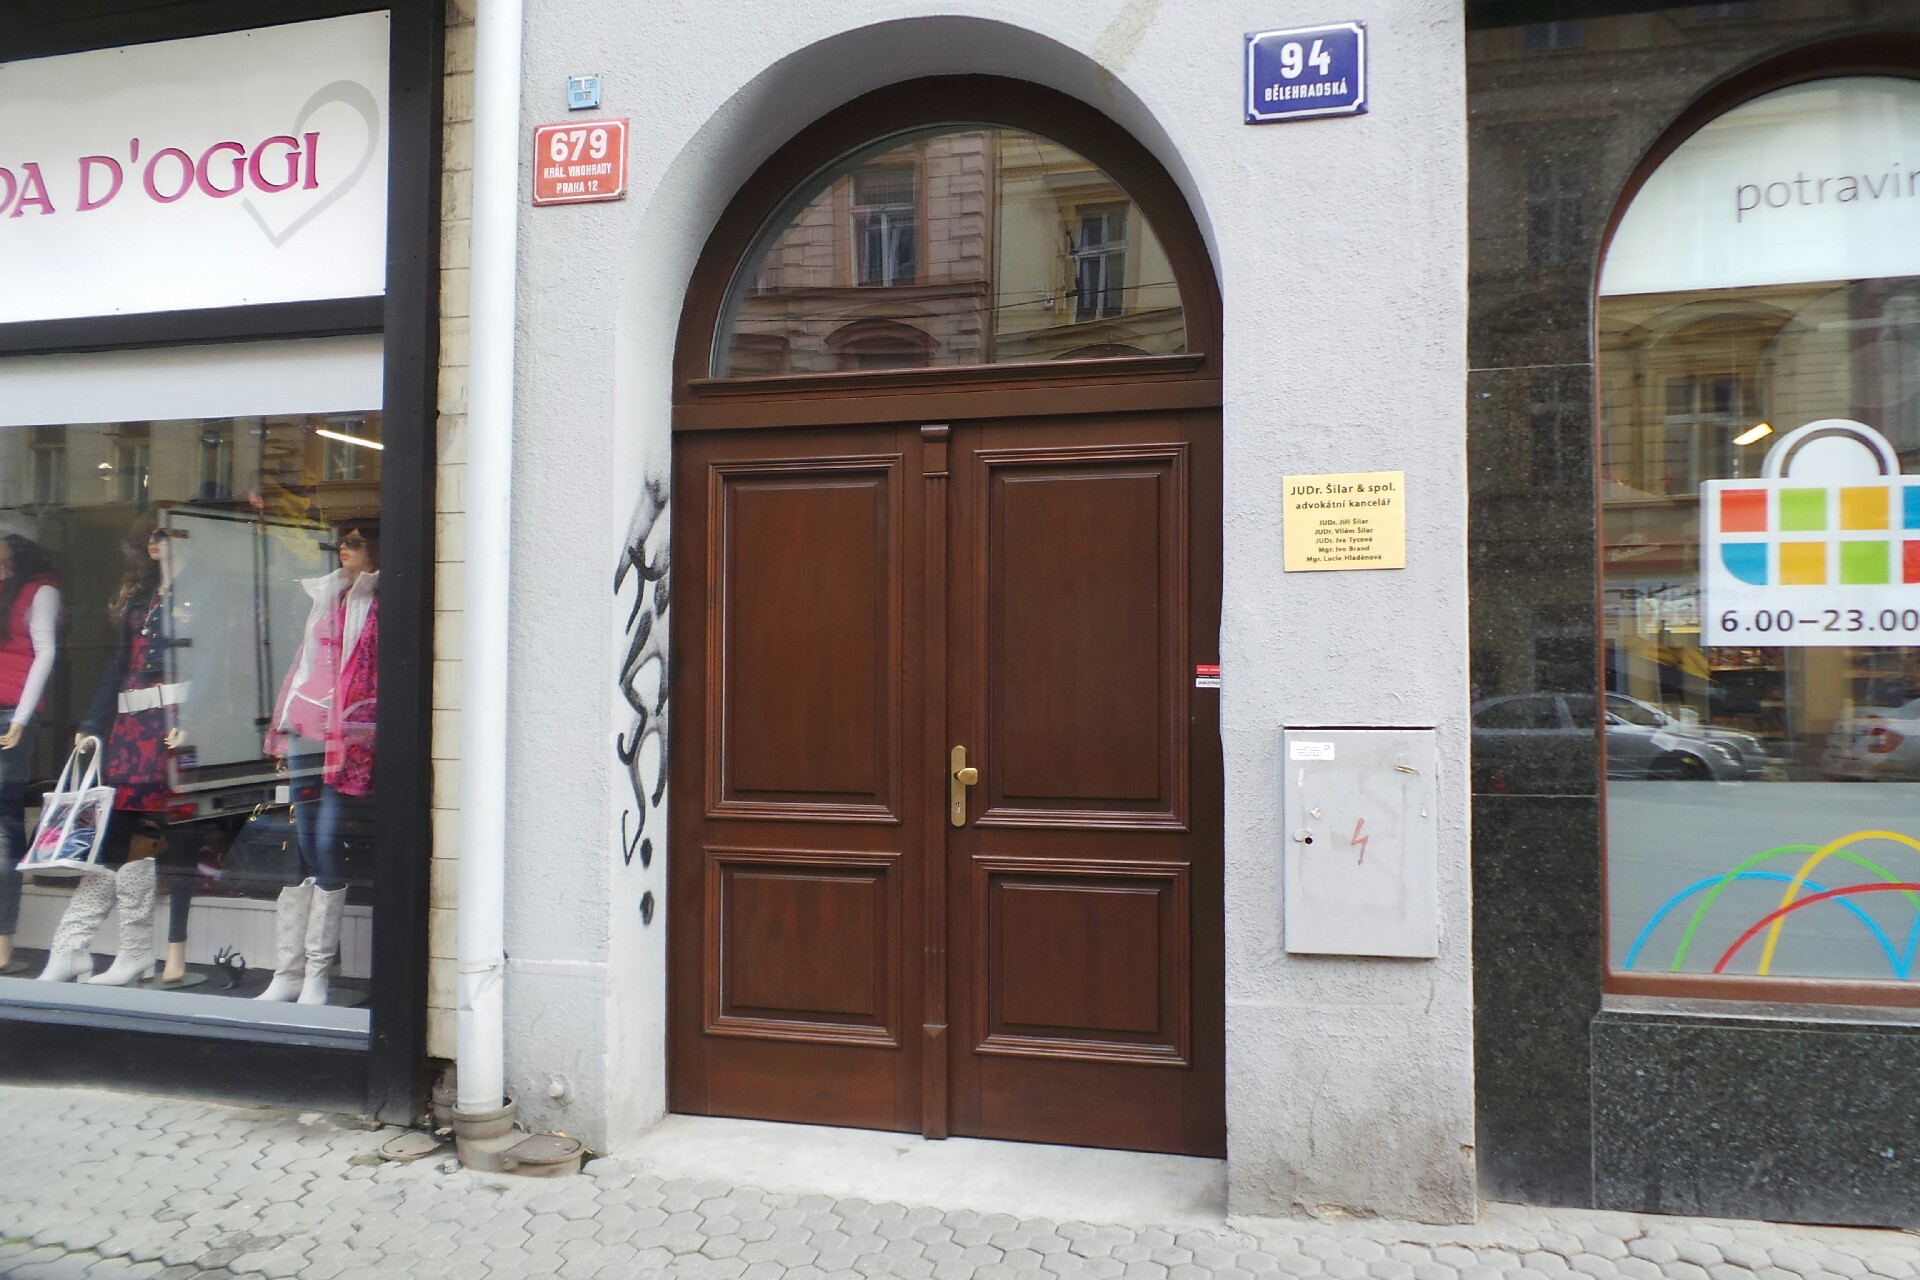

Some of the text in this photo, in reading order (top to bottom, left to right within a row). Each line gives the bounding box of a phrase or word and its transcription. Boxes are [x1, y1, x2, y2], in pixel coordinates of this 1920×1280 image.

[1280, 39, 1331, 79] 94
[1264, 77, 1348, 102] BĚLEHRADSKÁ
[550, 128, 608, 162] 679
[76, 131, 321, 213] D'OGGI
[543, 162, 612, 179] KRÁL. VINOHRADY
[556, 180, 598, 194] PRAHA 12
[1291, 482, 1396, 496] JUDr. Šilar & spol.
[1296, 498, 1391, 510] advokátní kancelář
